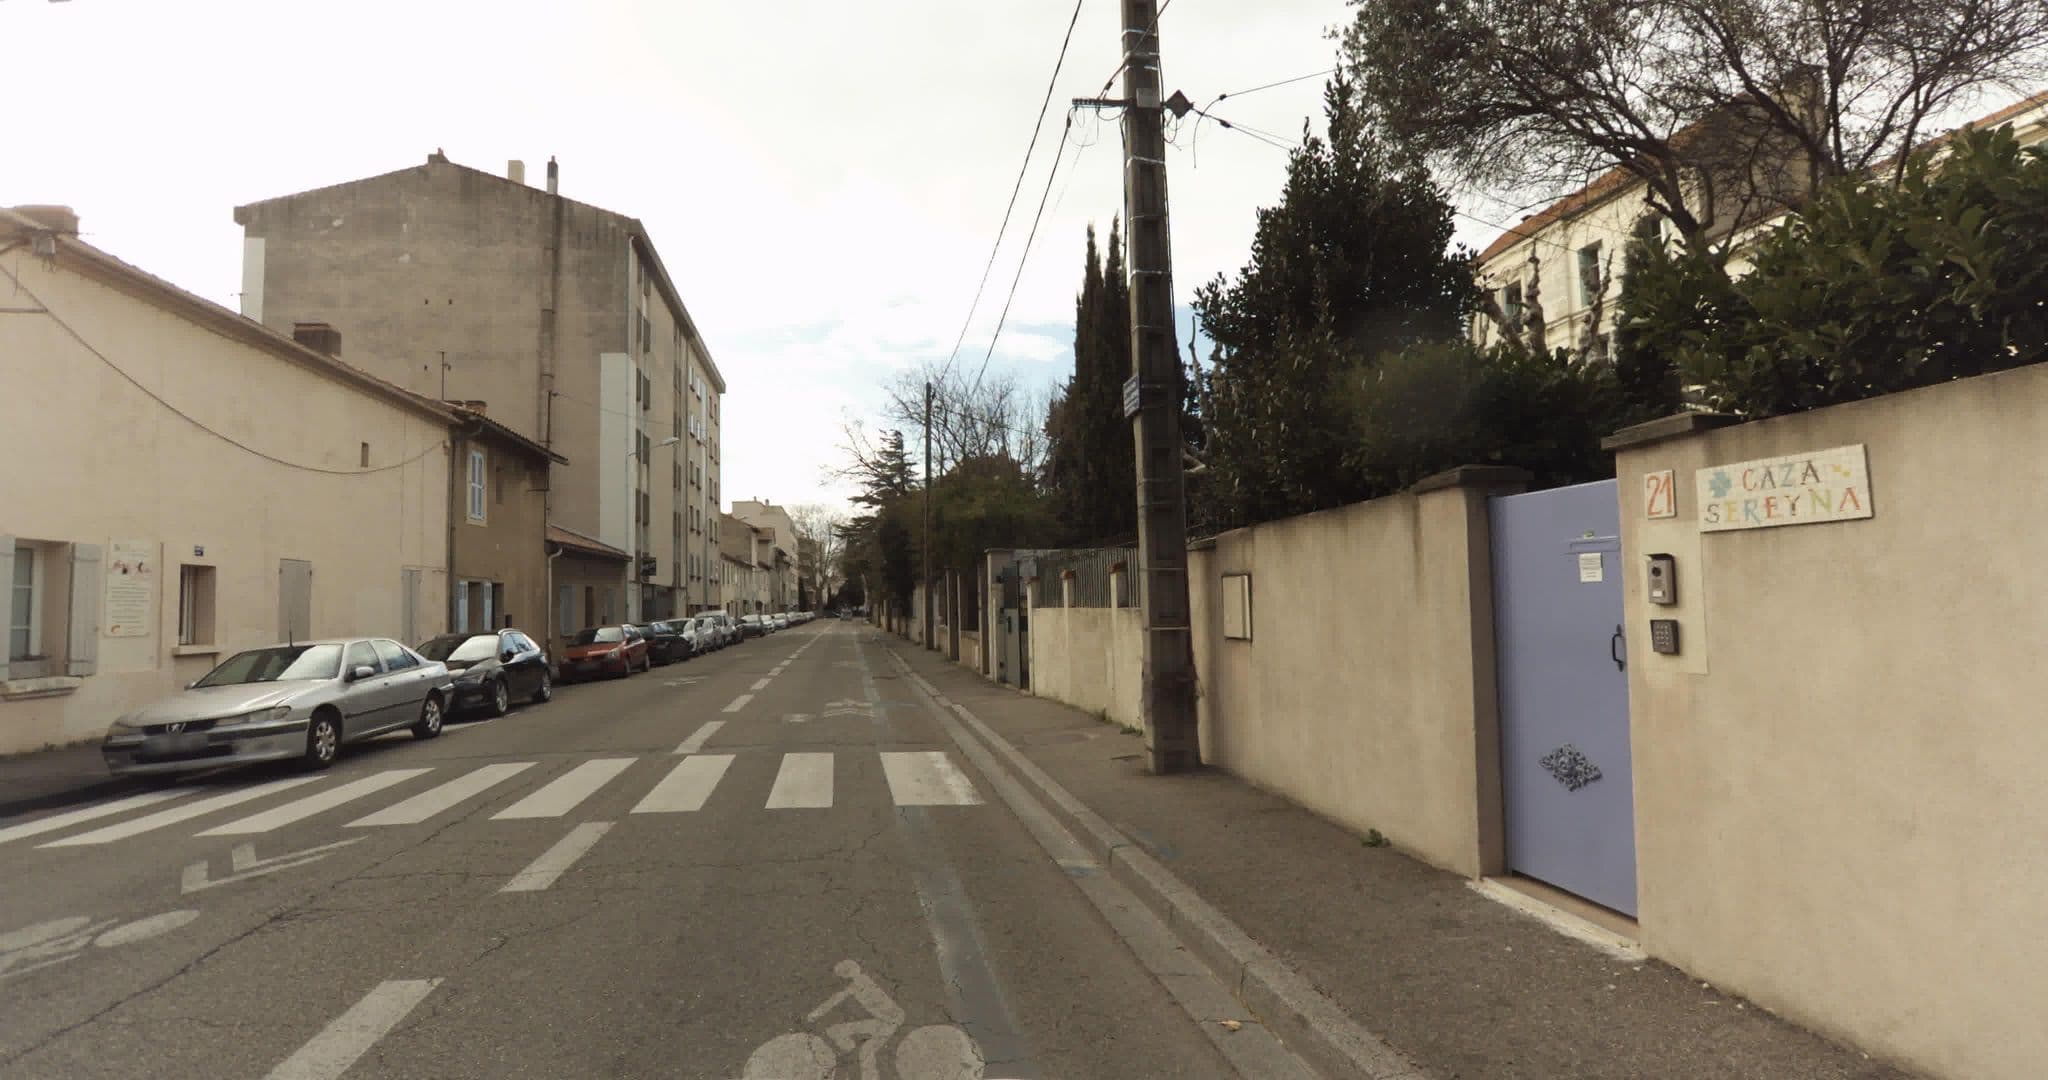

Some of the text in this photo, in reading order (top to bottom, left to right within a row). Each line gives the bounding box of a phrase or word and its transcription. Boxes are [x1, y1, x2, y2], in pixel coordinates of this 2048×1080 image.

[1742, 459, 1821, 492] CAZA
[1647, 474, 1672, 516] 21
[1704, 487, 1861, 525] SEREYNA
